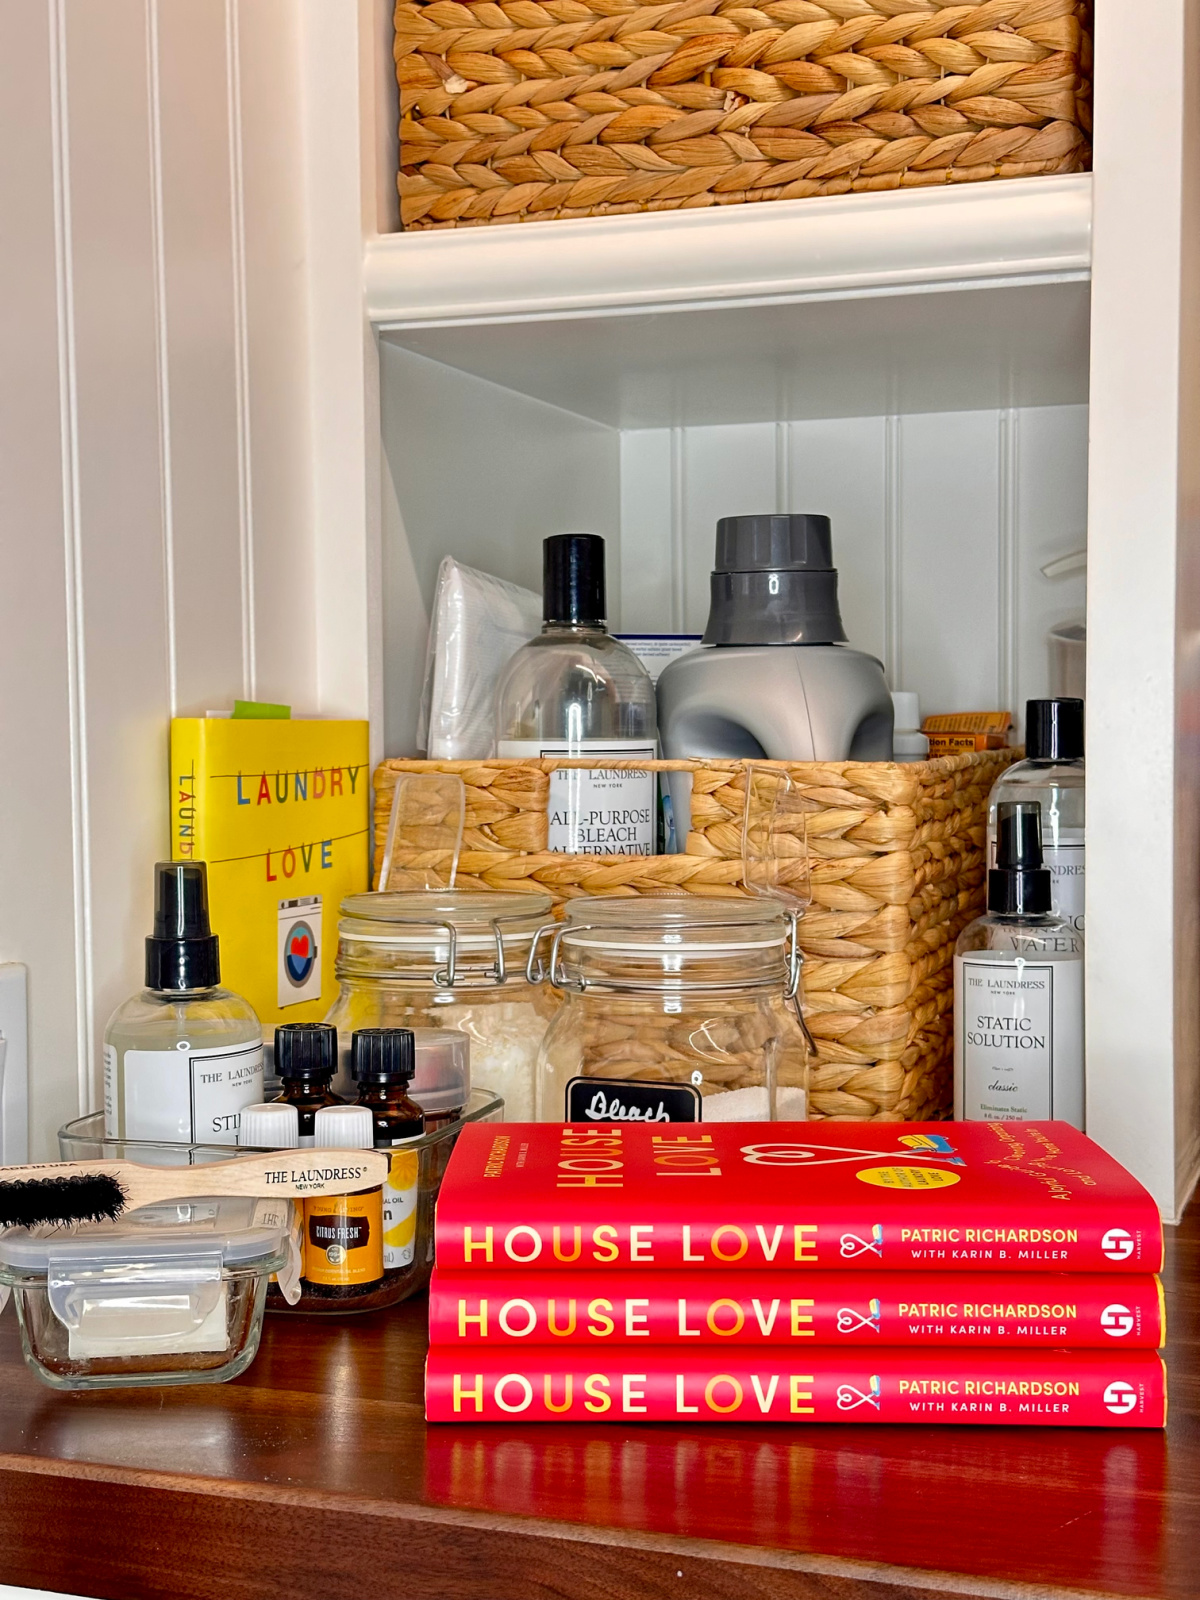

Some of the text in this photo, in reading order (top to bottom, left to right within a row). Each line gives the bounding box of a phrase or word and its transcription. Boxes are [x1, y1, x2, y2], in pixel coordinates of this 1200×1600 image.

[588, 769, 648, 780] LAUNDRESS
[236, 766, 360, 806] LAUNDRY
[178, 774, 197, 861] LAUND
[266, 840, 333, 882] LOVE
[968, 977, 1045, 990] THE LAUNDRESS
[977, 1015, 1032, 1032] STATIC
[967, 1031, 1046, 1049] SOLUTION
[200, 1072, 222, 1084] THE
[988, 1080, 1018, 1093] classic
[585, 1090, 671, 1122] Bleach
[556, 1129, 624, 1188] HOUSE
[652, 1135, 722, 1176] LOVE
[265, 1171, 288, 1184] THE
[316, 1226, 336, 1239] CITRUS
[901, 1228, 1078, 1243] PATRIC RICHARDSON
[464, 1224, 818, 1262] HOUSE LOVE
[911, 1250, 1068, 1260] WITH KARIN B. MILLER
[458, 1298, 816, 1336] HOUSE LOVE
[898, 1303, 1076, 1318] PATRIC RICHARDSON
[908, 1325, 1067, 1335] WITH KARIN B. MILLER
[452, 1373, 815, 1413] HOUSE LOVE
[899, 1380, 1080, 1396] PATRIC RICHARDSON
[909, 1402, 1070, 1413] WITH KARIN B. MILLER
